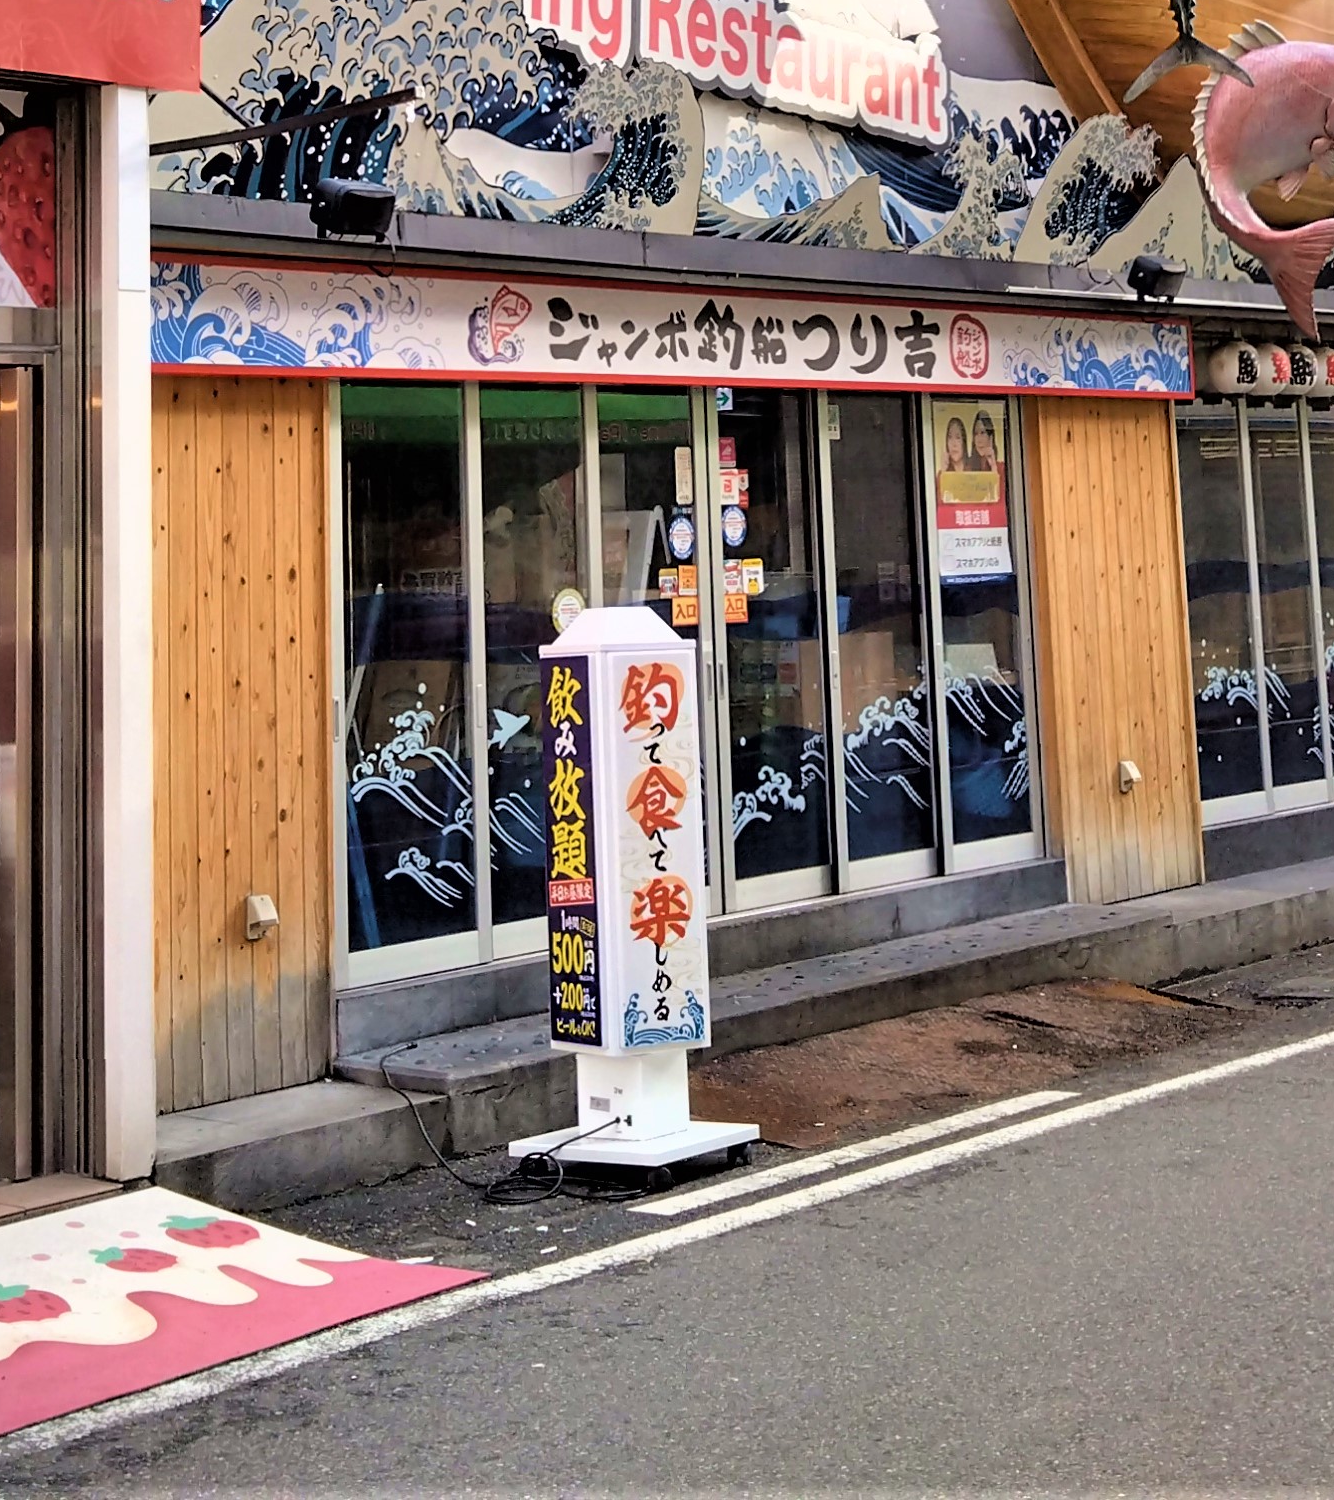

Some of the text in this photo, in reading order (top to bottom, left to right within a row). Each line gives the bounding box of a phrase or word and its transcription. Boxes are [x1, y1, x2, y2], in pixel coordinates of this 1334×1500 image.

[547, 297, 941, 379] ジャンボ釣船つり吉
[675, 604, 697, 620] 入口
[727, 598, 744, 612] 入口
[546, 665, 588, 880] 飲み放題
